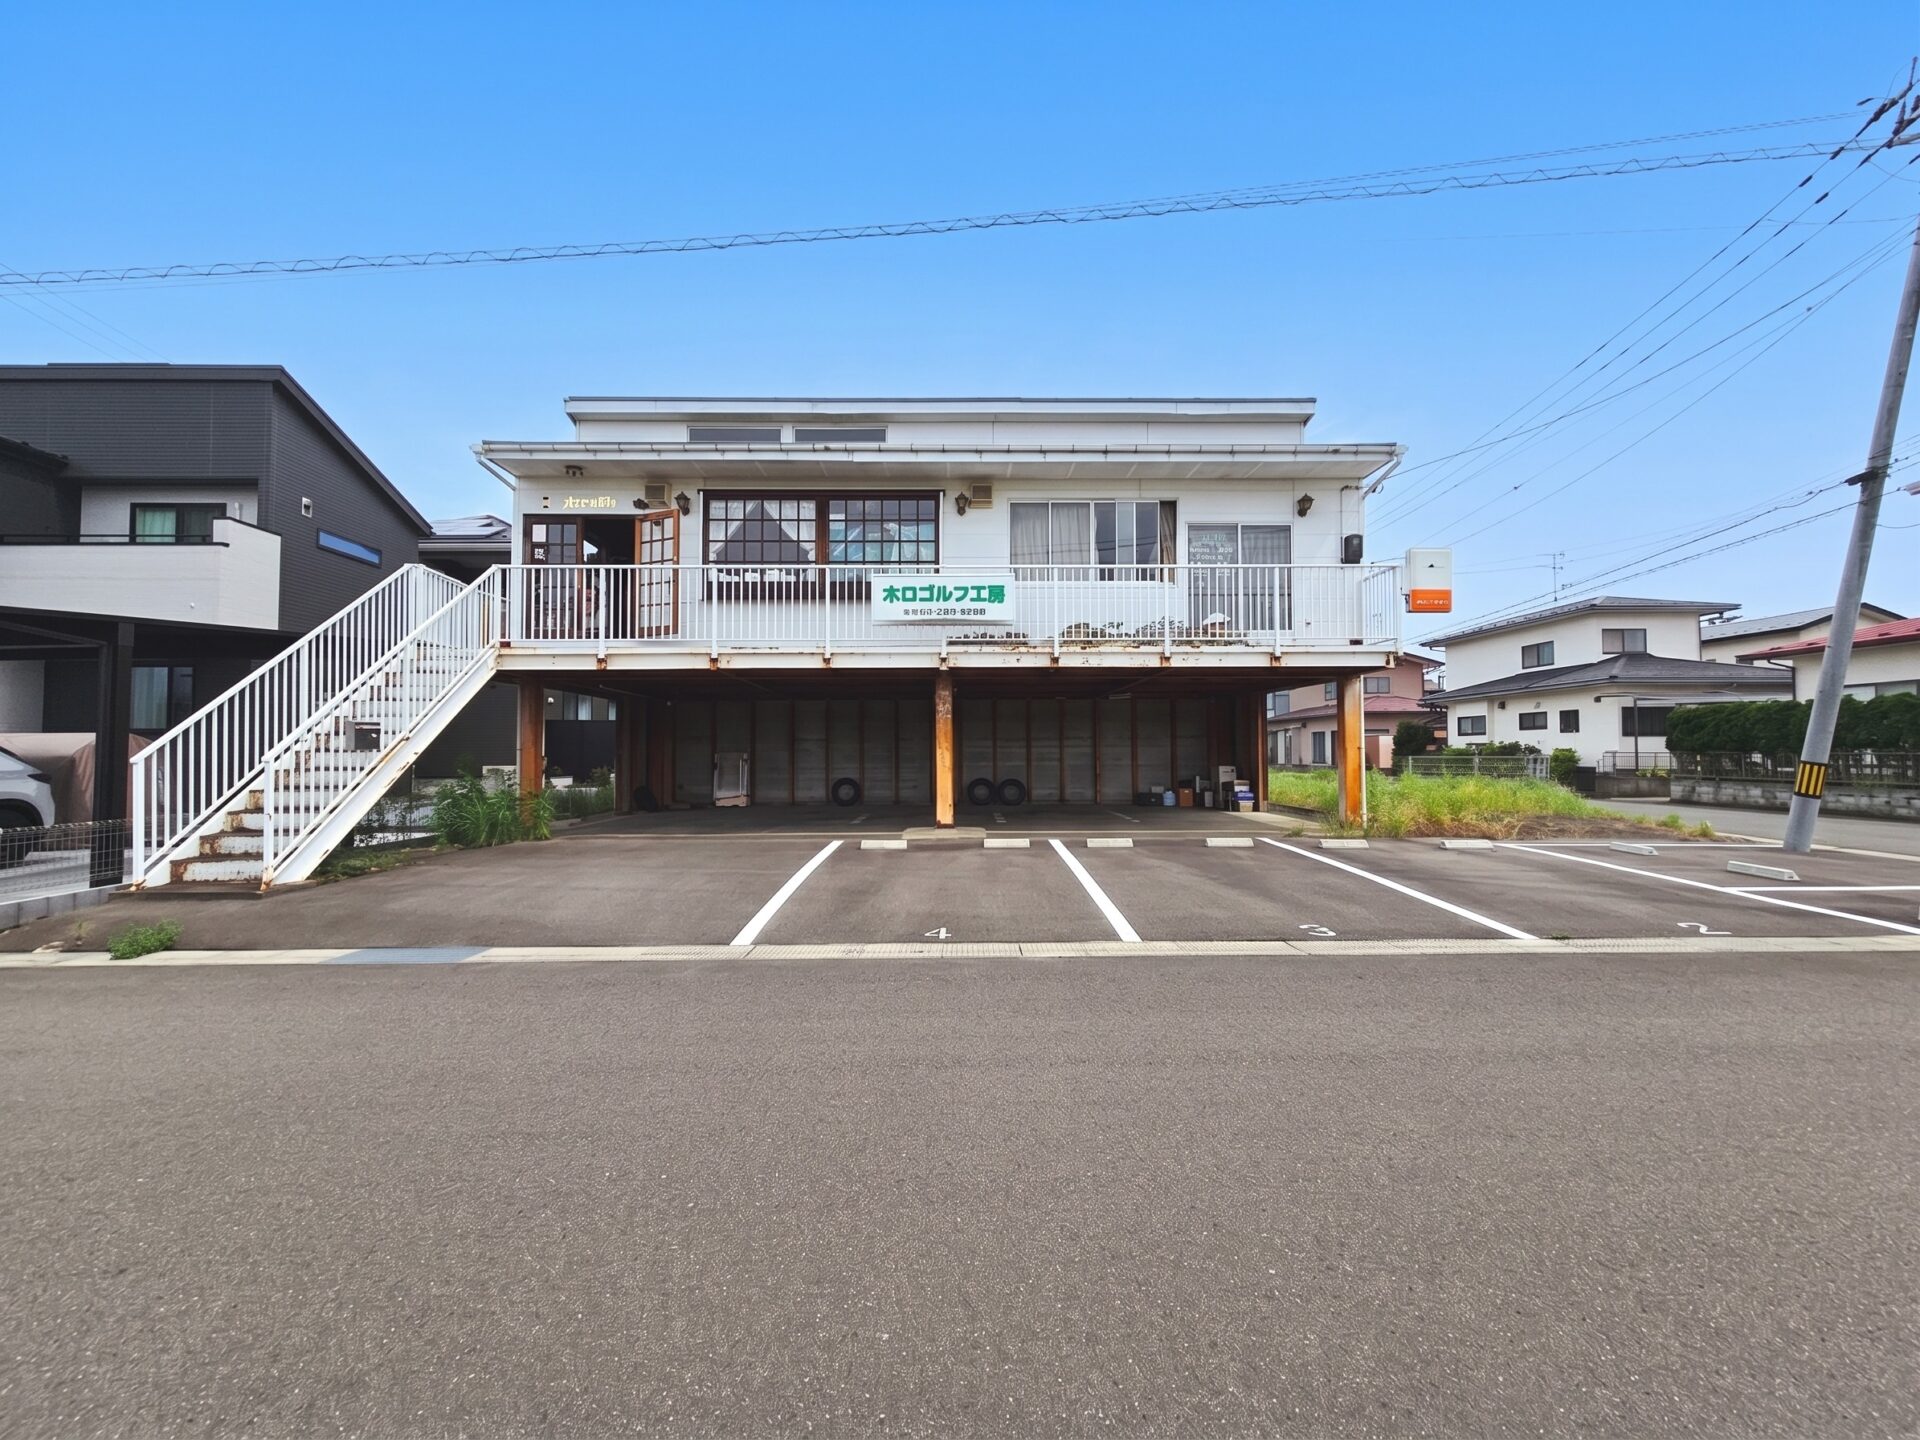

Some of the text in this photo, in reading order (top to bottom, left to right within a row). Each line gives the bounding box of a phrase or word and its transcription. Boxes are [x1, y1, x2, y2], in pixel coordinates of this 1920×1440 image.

[882, 584, 1006, 604] 木口ゴルフ工房
[924, 927, 952, 939] 4
[1298, 924, 1337, 937] 3
[1676, 922, 1732, 935] 2
